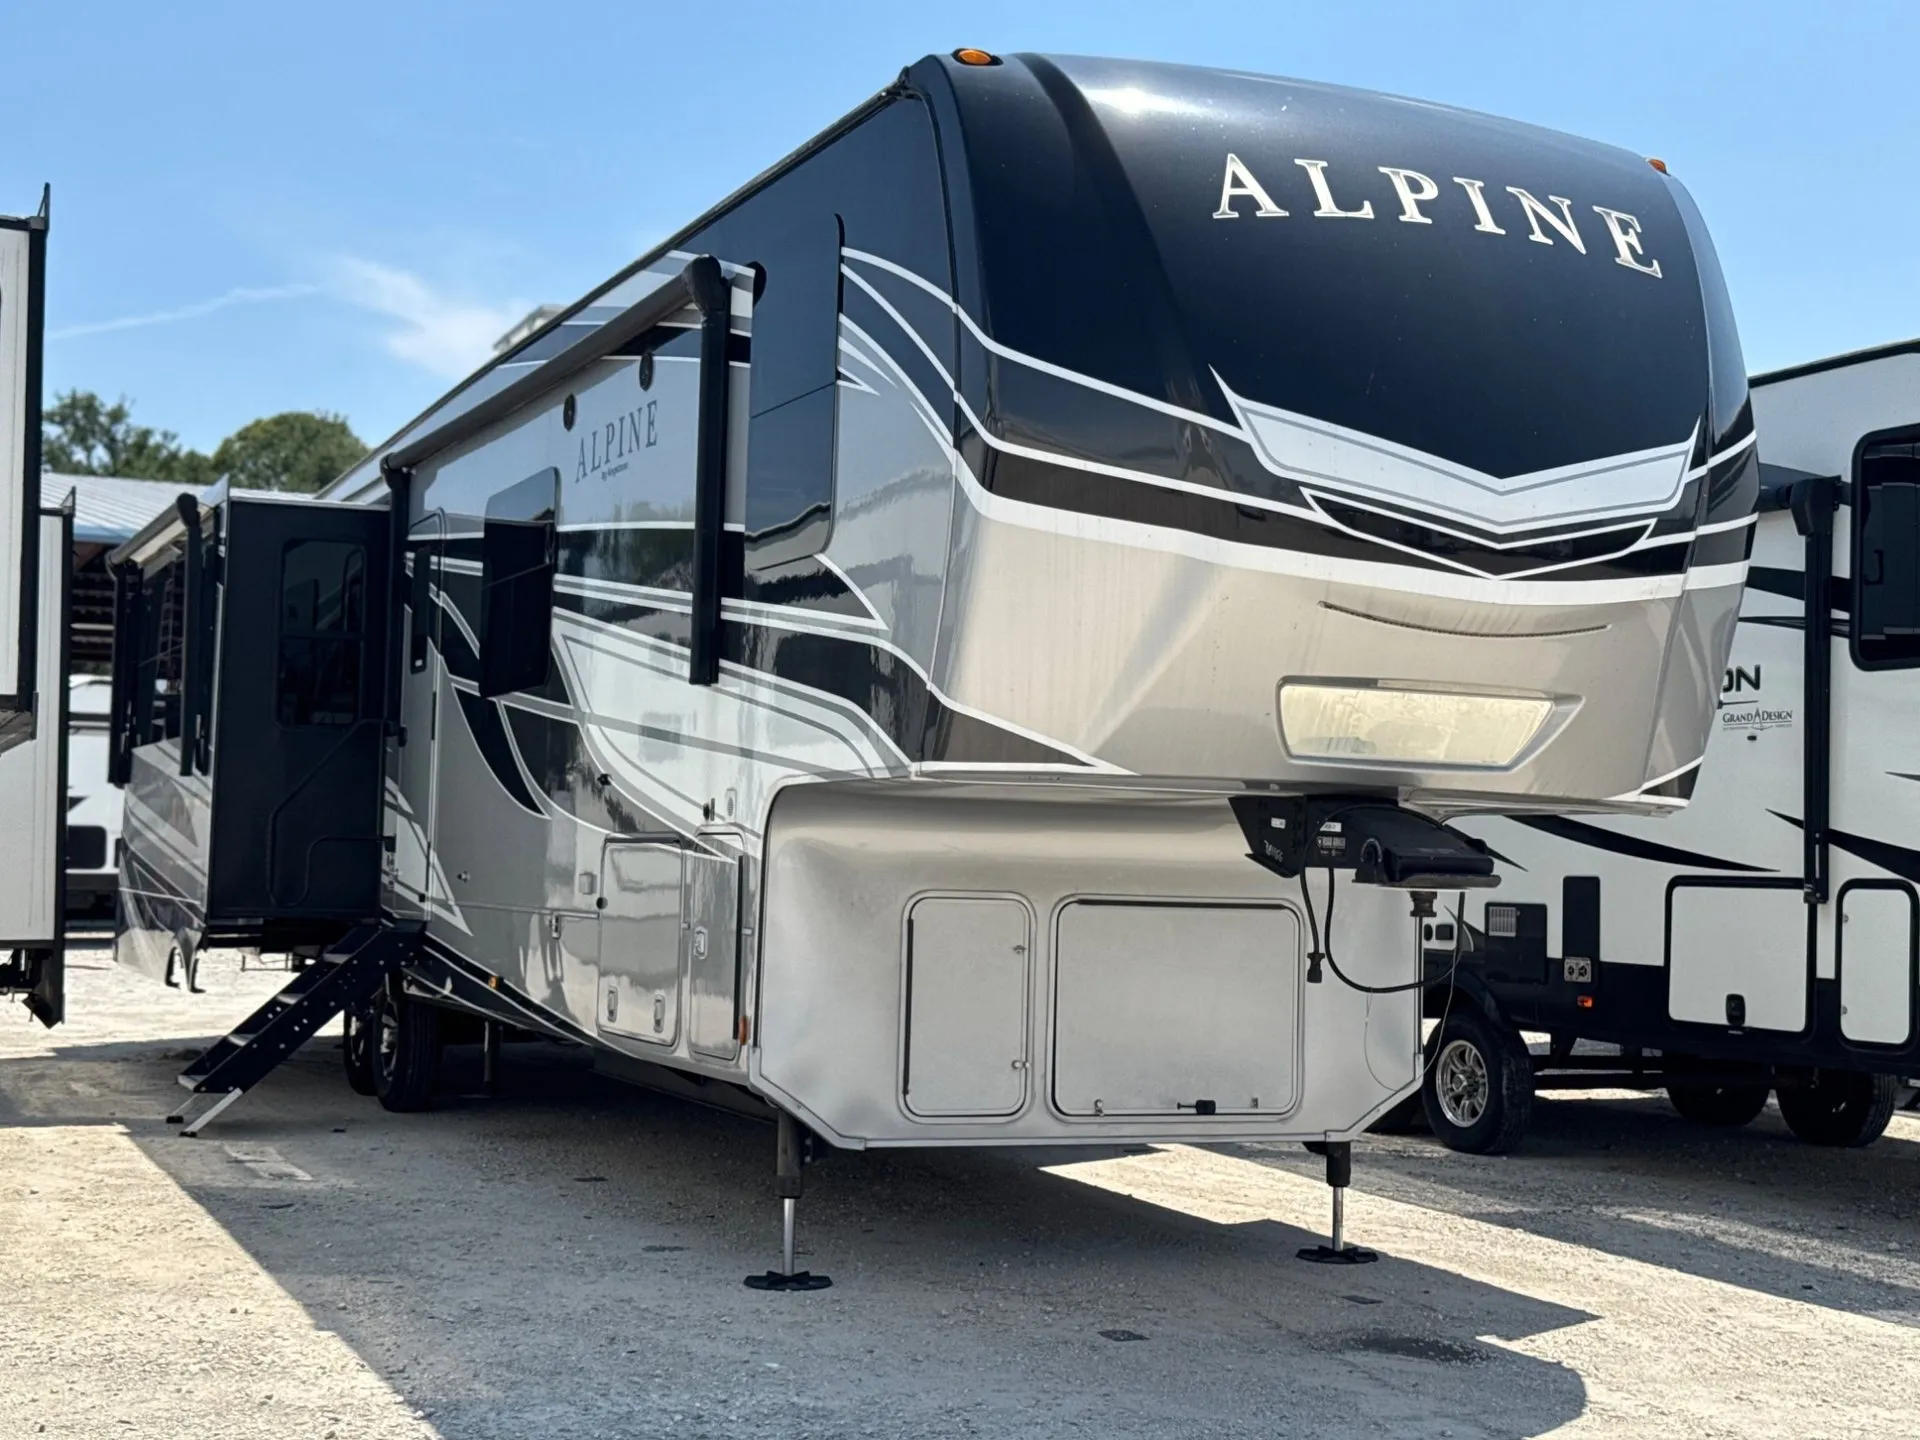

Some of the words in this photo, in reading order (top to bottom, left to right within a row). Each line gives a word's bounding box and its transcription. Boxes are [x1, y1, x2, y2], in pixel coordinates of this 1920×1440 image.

[1212, 153, 1663, 279] ALPINE
[575, 400, 657, 484] ALPINE
[1723, 712, 1753, 723] GRAND
[1762, 710, 1793, 721] DESIGN
